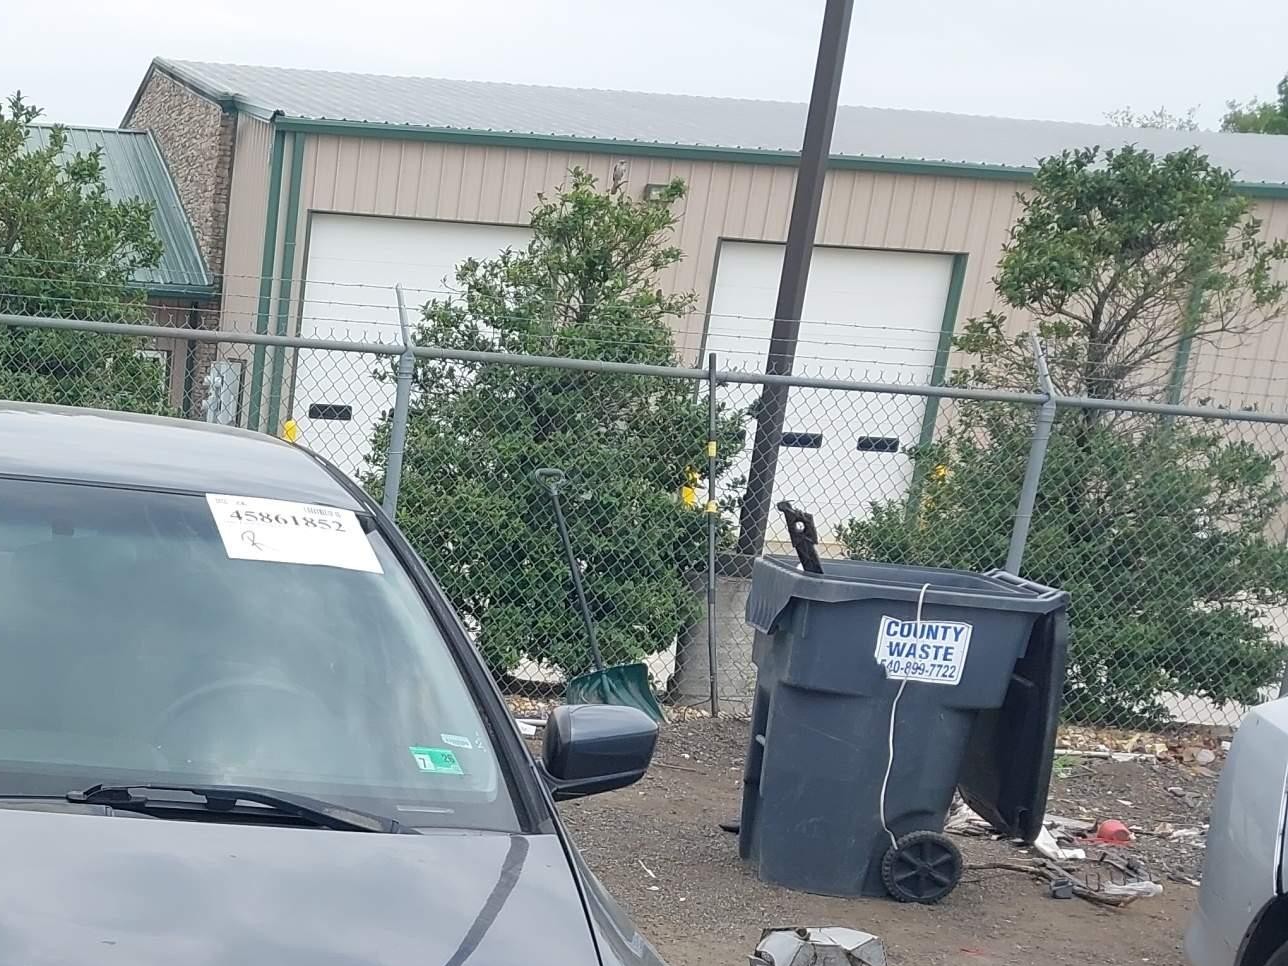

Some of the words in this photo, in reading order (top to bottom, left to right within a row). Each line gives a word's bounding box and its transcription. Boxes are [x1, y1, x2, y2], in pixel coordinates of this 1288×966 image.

[230, 509, 346, 533] 45861852
[886, 620, 965, 642] COUNTY
[888, 641, 955, 662] WASTE
